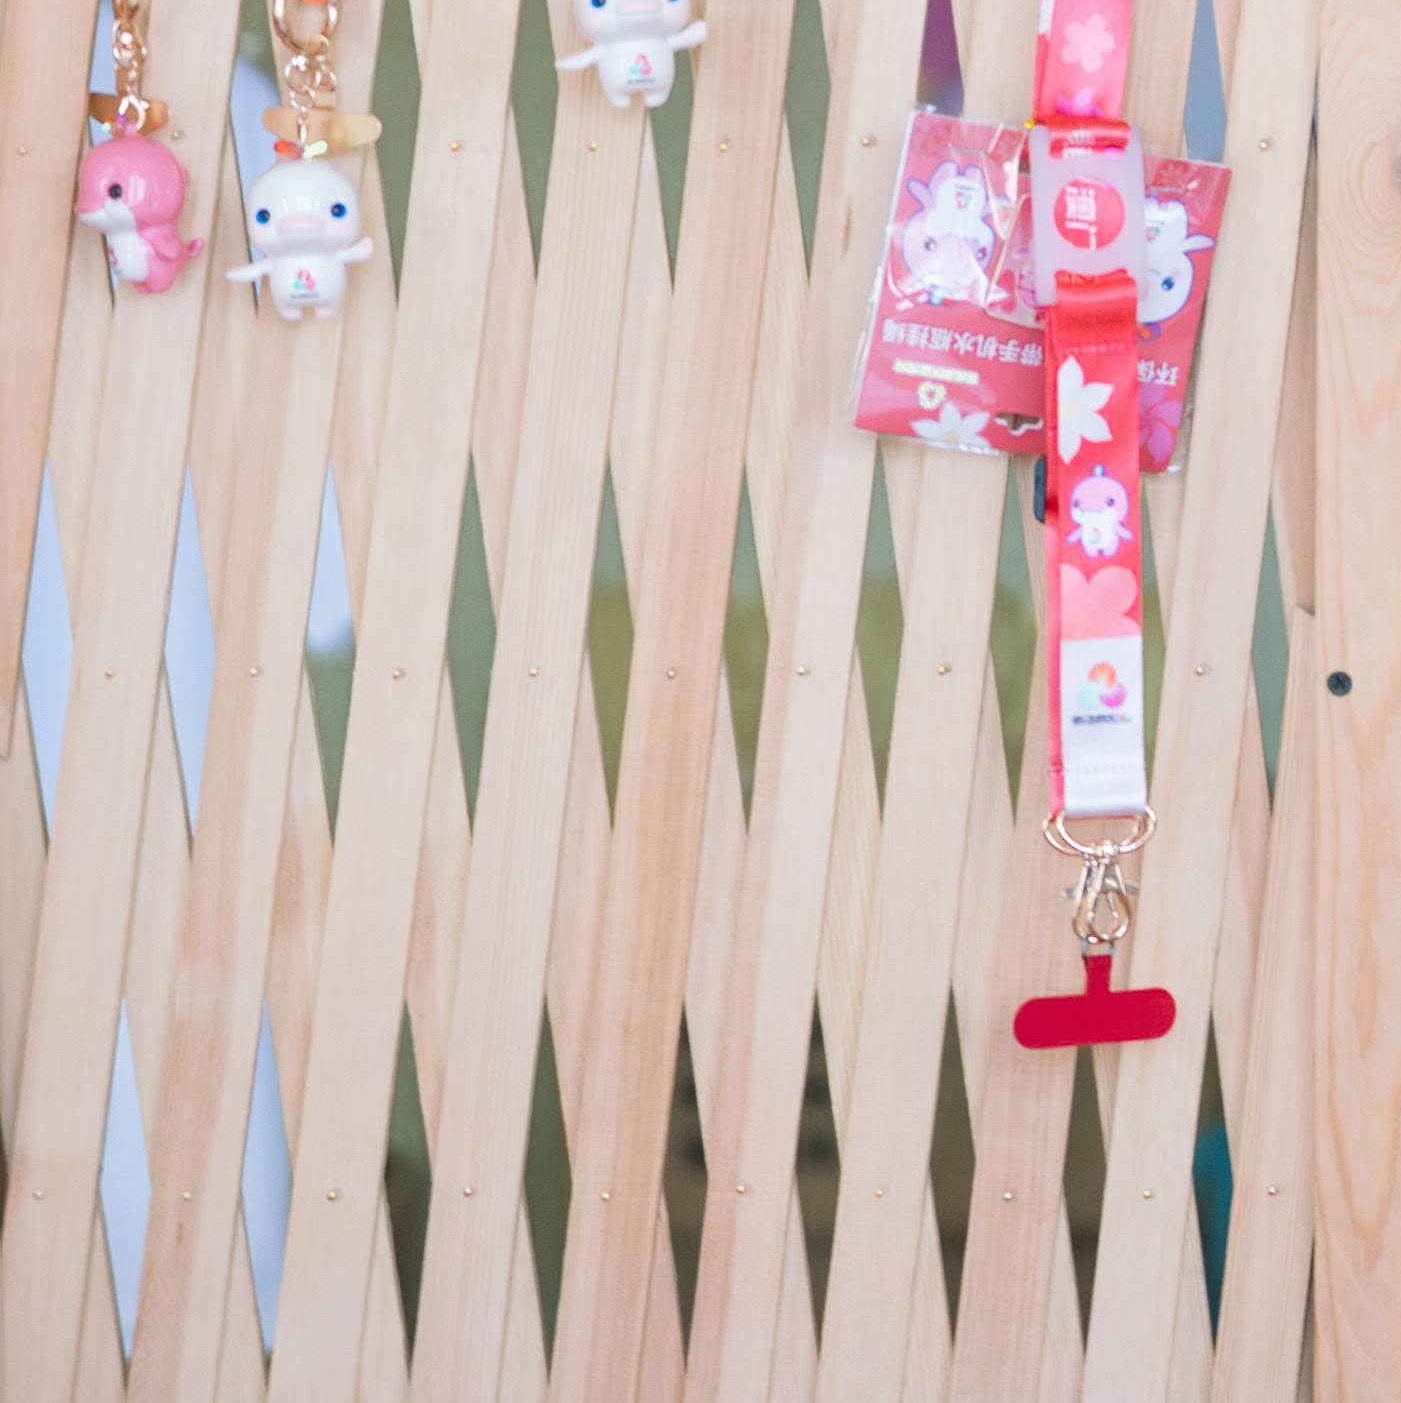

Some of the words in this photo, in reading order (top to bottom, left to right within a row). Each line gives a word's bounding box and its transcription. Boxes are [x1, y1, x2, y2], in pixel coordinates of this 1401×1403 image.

[882, 317, 1044, 367] 带手机水瓶挂绳
